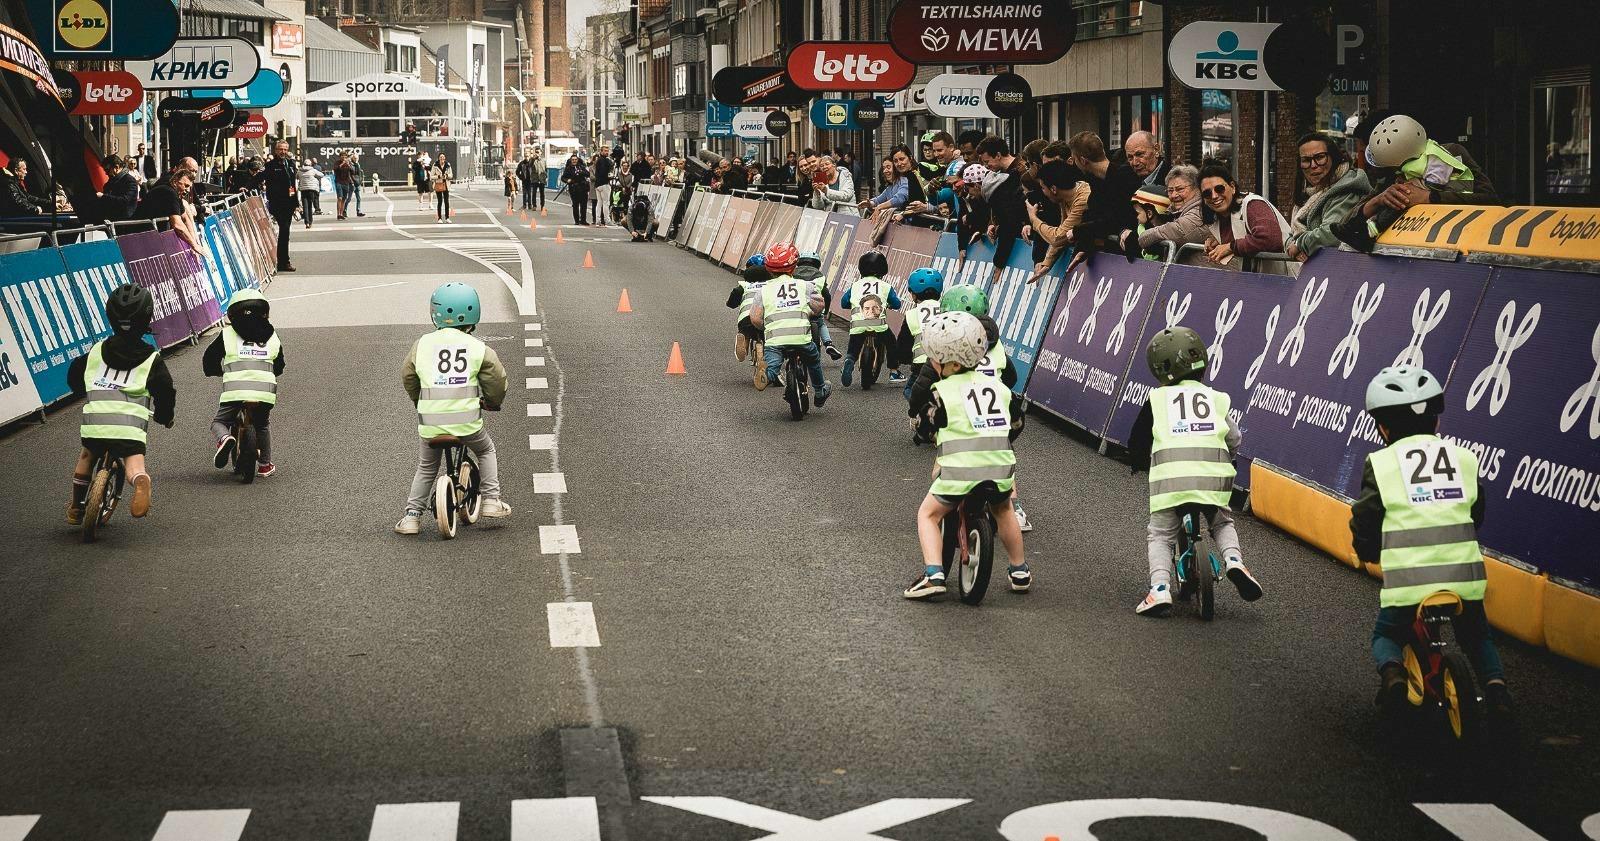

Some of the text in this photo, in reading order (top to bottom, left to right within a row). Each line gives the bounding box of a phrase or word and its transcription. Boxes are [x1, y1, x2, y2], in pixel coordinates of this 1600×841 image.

[920, 4, 1042, 19] TEXTILSHARING
[957, 28, 1043, 52] MEWA
[1337, 24, 1364, 65] P
[150, 59, 229, 81] KPMG
[813, 50, 889, 82] lotto
[1195, 63, 1258, 80] KBC
[85, 82, 133, 103] lotto
[1333, 78, 1369, 92] 30 MIN
[938, 95, 980, 107] KPMG
[740, 123, 763, 131] KPMG
[776, 282, 799, 300] 45
[862, 281, 879, 295] 21
[437, 348, 468, 374] 85
[1083, 366, 1118, 396] proximus
[966, 387, 1002, 416] 12
[1119, 380, 1156, 409] proxi
[1172, 392, 1211, 420] 16
[1246, 382, 1297, 417] proximus
[1292, 394, 1352, 434] proximus
[1405, 446, 1457, 485] 24
[1505, 455, 1600, 512] proximus
